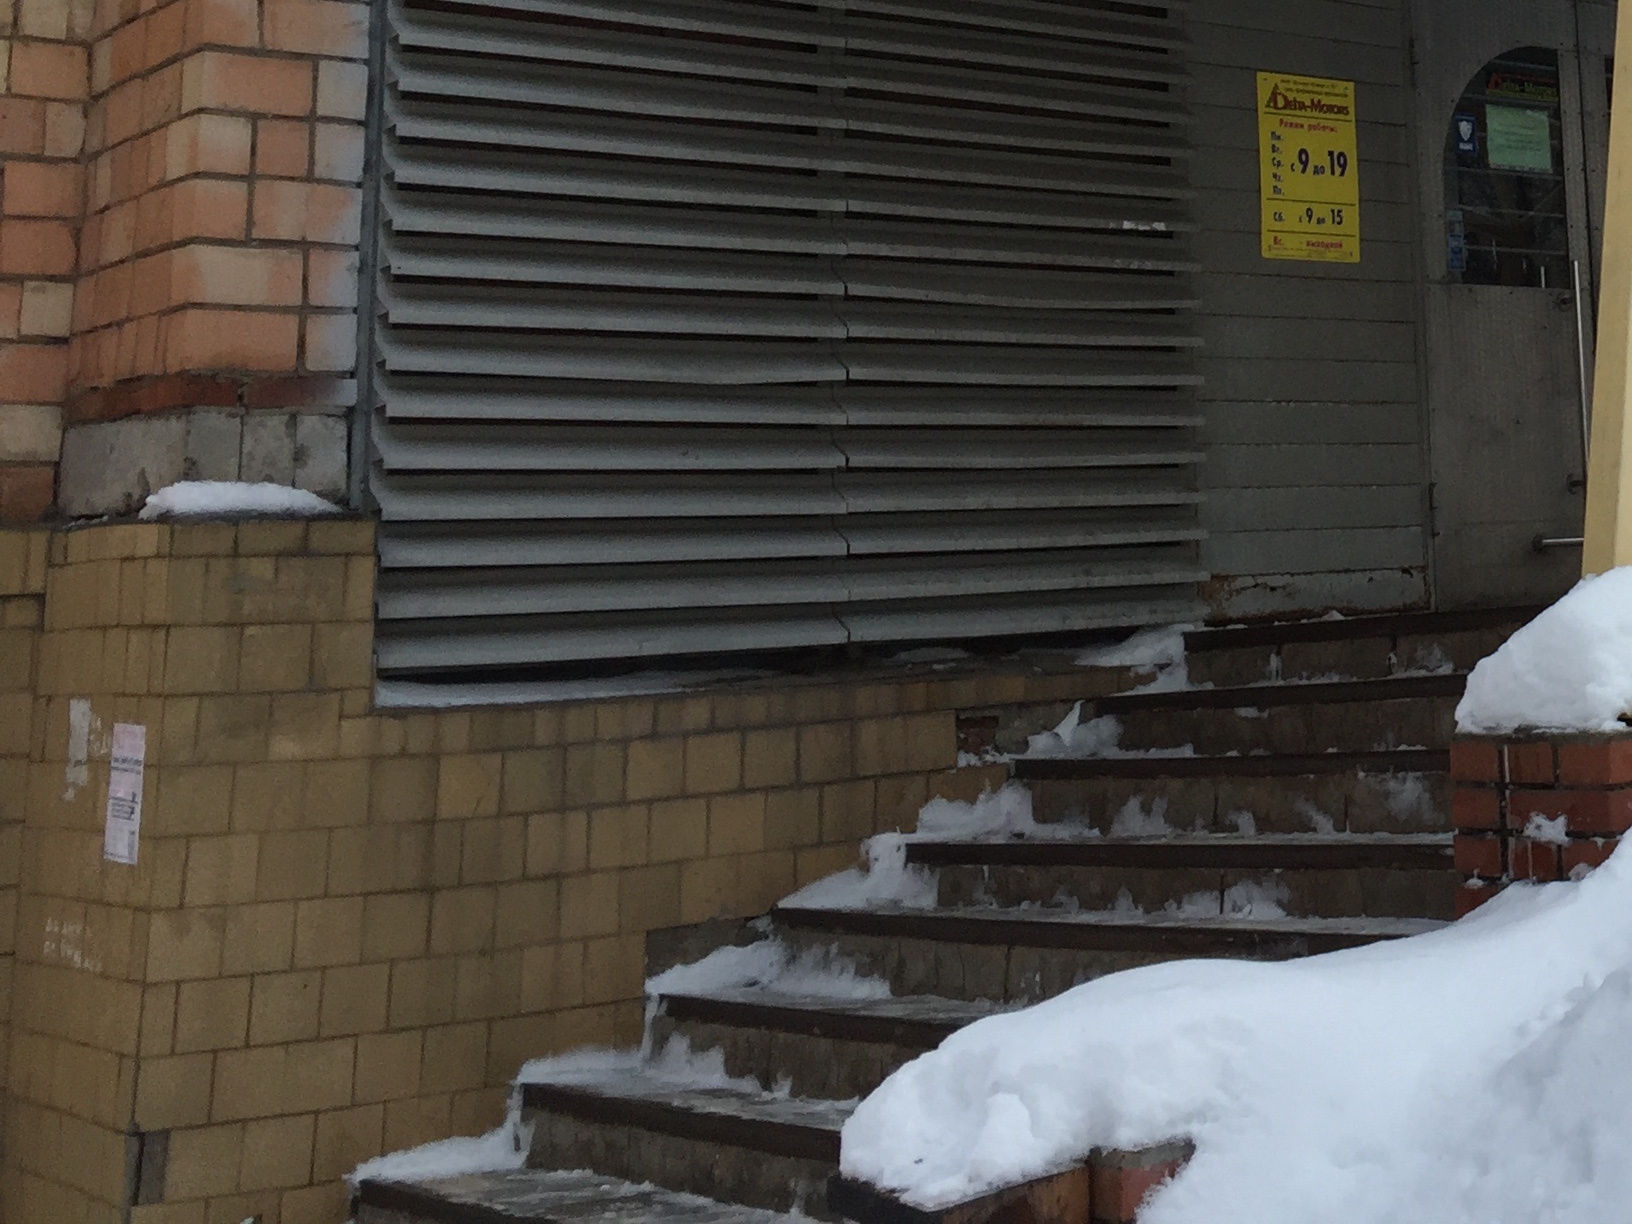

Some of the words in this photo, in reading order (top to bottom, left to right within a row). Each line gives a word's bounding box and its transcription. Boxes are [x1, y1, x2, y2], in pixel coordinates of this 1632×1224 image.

[1298, 148, 1309, 174] 9
[1327, 150, 1347, 177] 19
[1306, 207, 1313, 224] 9
[1330, 208, 1343, 225] 15
